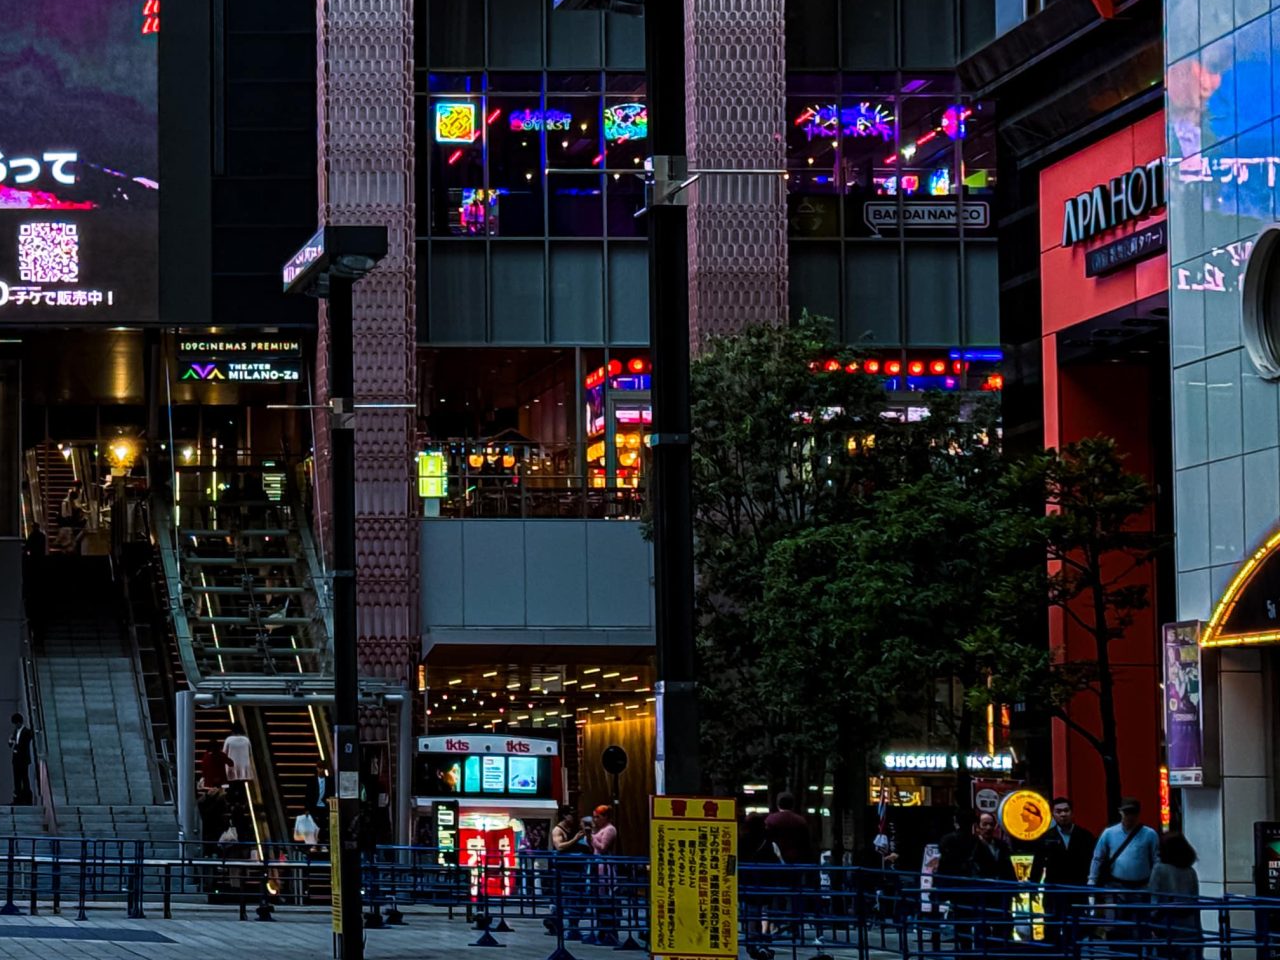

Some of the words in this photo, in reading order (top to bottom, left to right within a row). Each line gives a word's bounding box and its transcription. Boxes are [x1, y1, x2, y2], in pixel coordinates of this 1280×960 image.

[873, 209, 925, 221] BANDAI
[927, 209, 980, 221] NAMCO
[1062, 185, 1108, 247] APA
[251, 342, 299, 351] PREMIUM
[228, 370, 299, 380] MILANO-Za
[446, 739, 469, 752] tkts
[506, 740, 530, 753] tkts
[884, 754, 947, 769] SHOGUN
